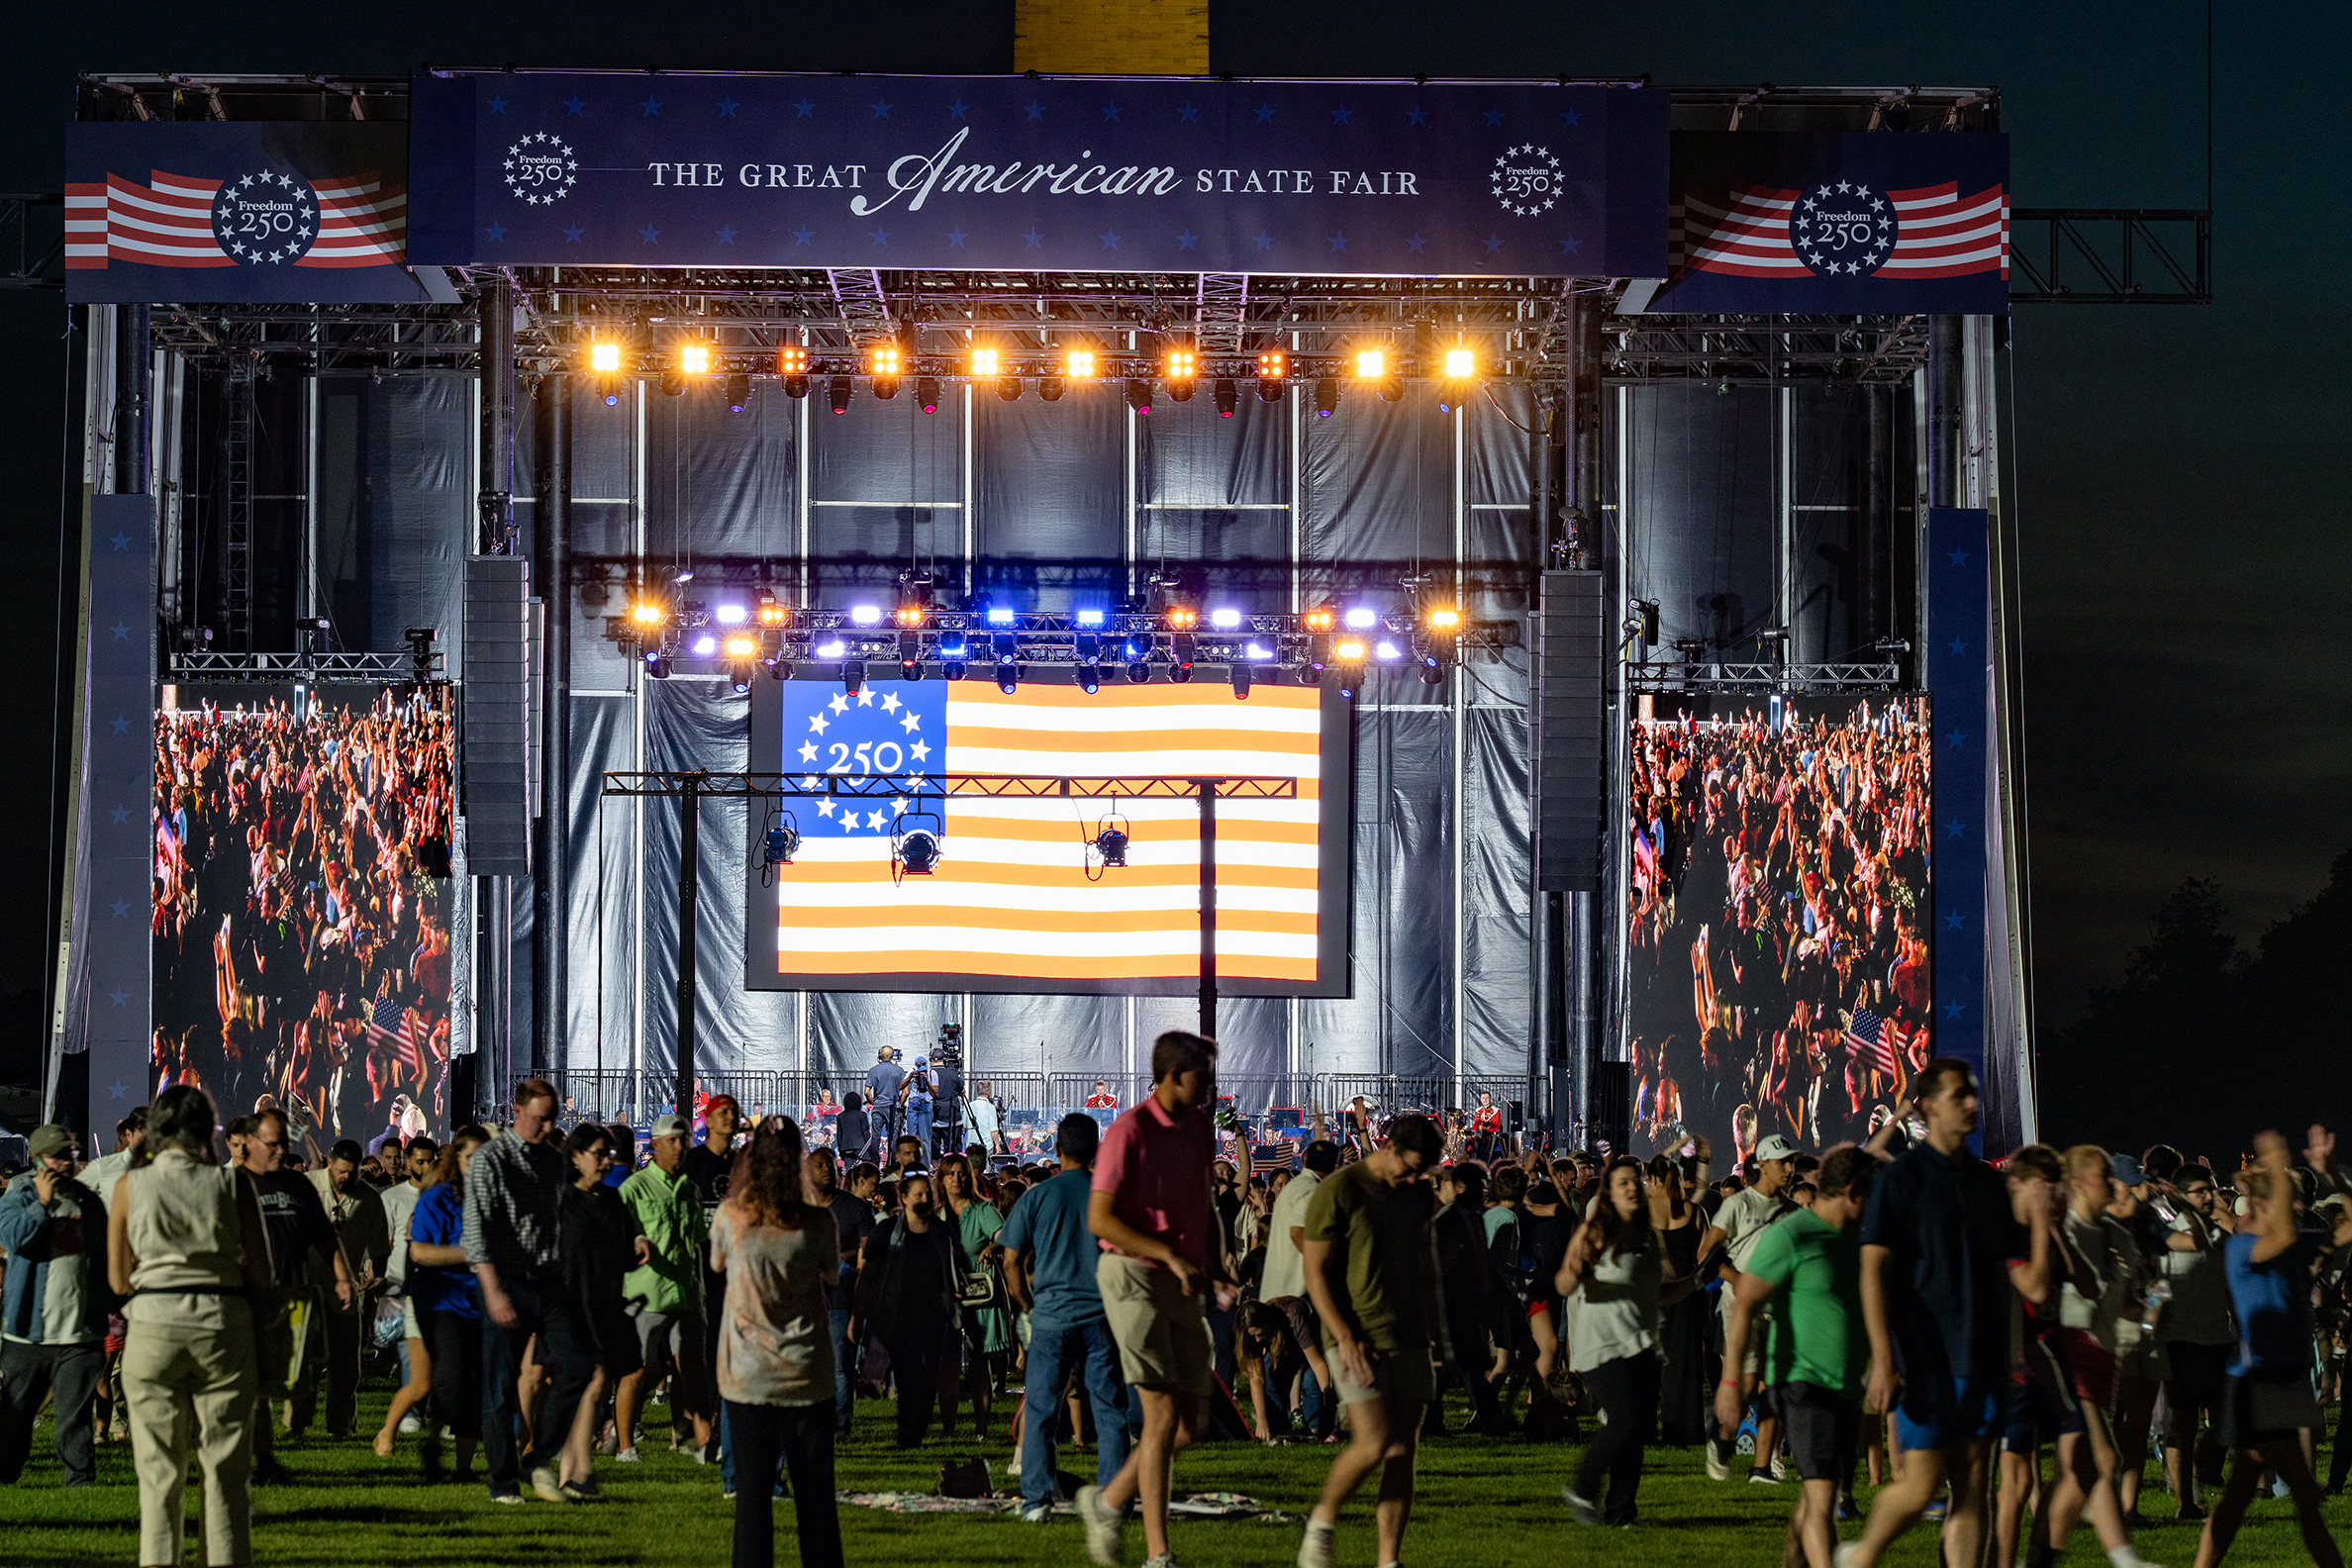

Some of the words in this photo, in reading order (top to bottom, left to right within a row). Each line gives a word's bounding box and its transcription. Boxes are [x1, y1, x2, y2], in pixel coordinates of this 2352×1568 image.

[519, 155, 562, 164] Freedom
[1506, 166, 1549, 176] Freedom
[519, 164, 562, 187] 250
[647, 162, 725, 187] THE
[738, 163, 867, 188] GREAT
[849, 126, 1183, 217] American
[1196, 168, 1315, 194] STATE
[1328, 170, 1421, 195] FAIR
[1506, 175, 1549, 198] 250
[238, 200, 294, 211] Freedom
[1816, 211, 1871, 222] Freedom
[239, 211, 294, 241] 250
[1816, 222, 1871, 250] 250
[826, 740, 903, 787] 250
